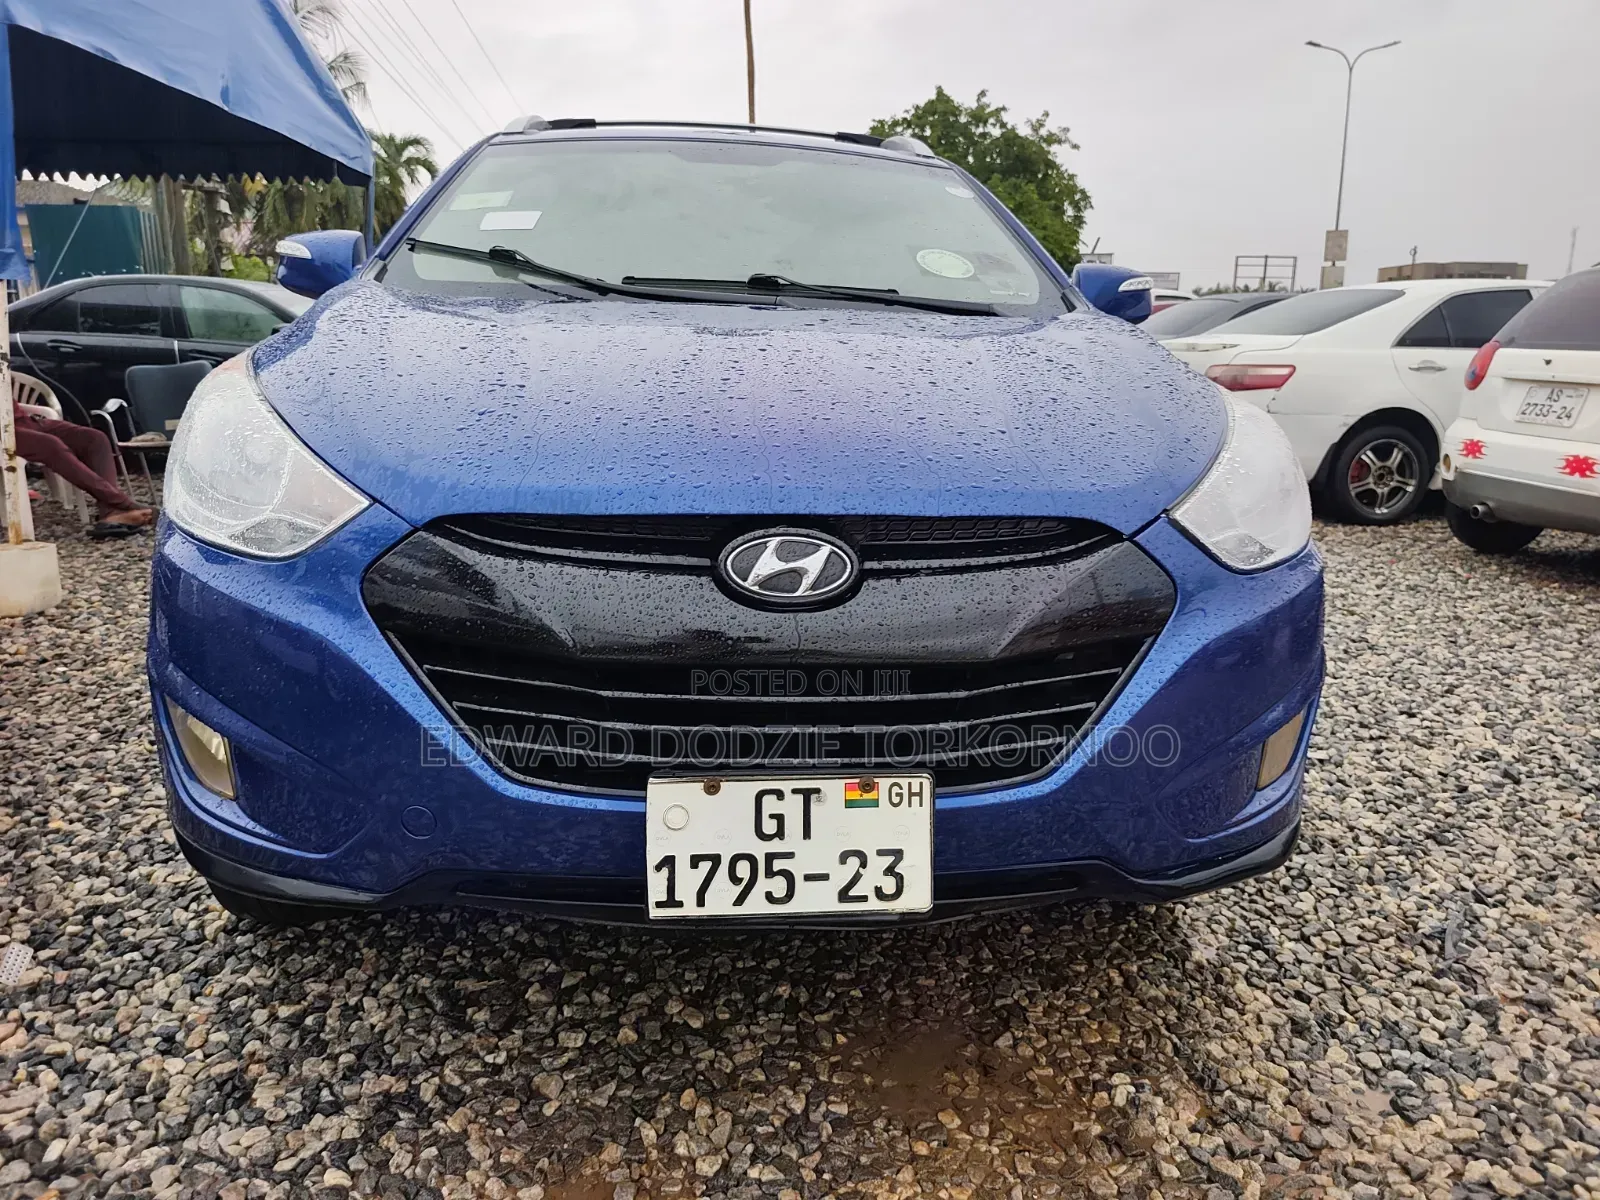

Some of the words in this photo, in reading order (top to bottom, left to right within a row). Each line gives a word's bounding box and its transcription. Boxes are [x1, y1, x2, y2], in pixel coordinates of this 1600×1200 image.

[1545, 388, 1563, 403] AS
[1520, 402, 1575, 420] 2733-24
[888, 781, 923, 808] GH
[754, 787, 821, 842] GT
[654, 848, 905, 908] 1795-23
